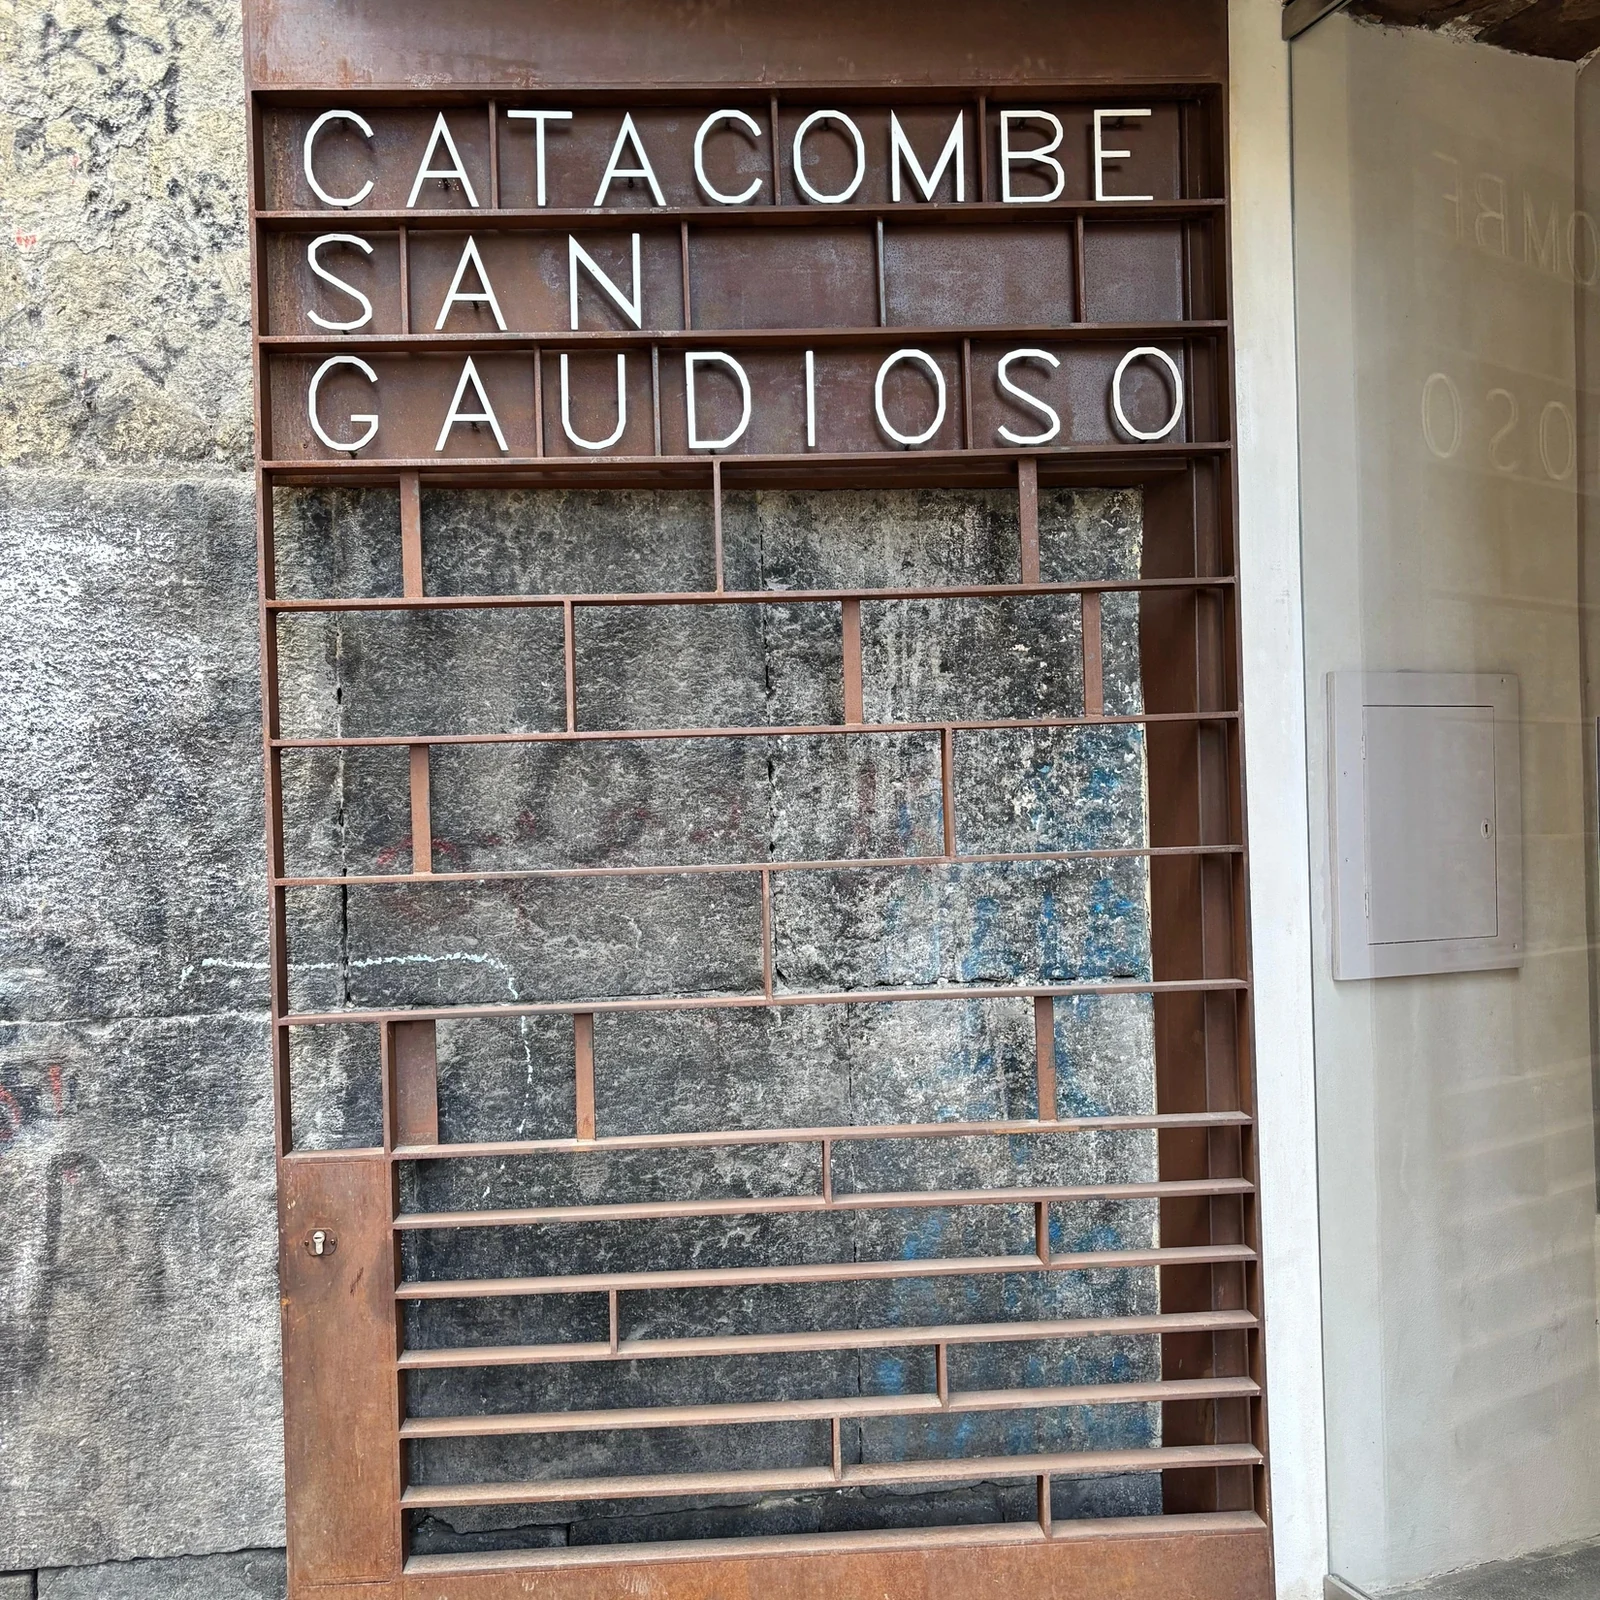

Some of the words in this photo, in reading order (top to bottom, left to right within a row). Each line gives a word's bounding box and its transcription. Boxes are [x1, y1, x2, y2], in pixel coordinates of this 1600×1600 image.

[303, 108, 1154, 208] CATACOMBE
[306, 232, 643, 332] SAN
[307, 346, 1184, 453] GAUDIOSO
